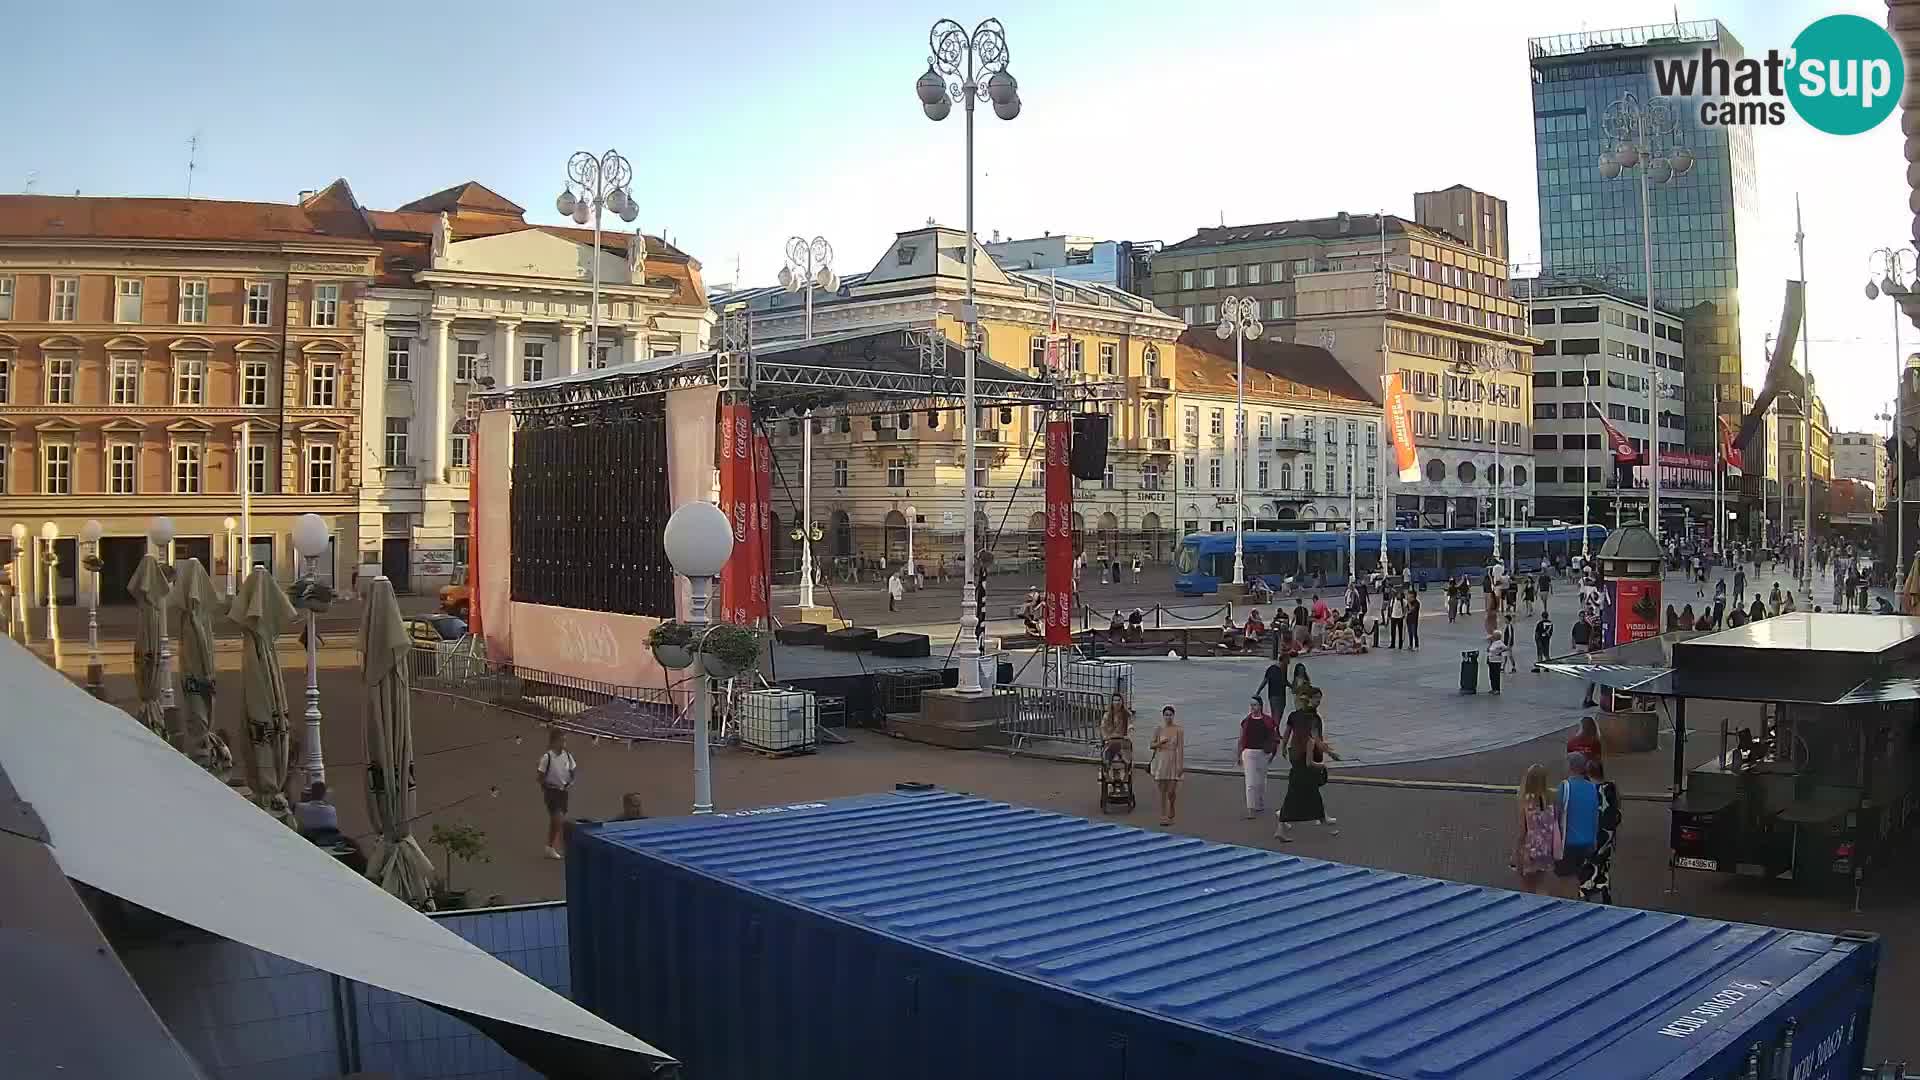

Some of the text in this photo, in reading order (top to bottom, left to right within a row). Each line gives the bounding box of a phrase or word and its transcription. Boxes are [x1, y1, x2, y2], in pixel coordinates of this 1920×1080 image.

[1137, 492, 1166, 501] SINGER
[1657, 1016, 1708, 1037] MCDU
[1691, 989, 1747, 1017] 300629
